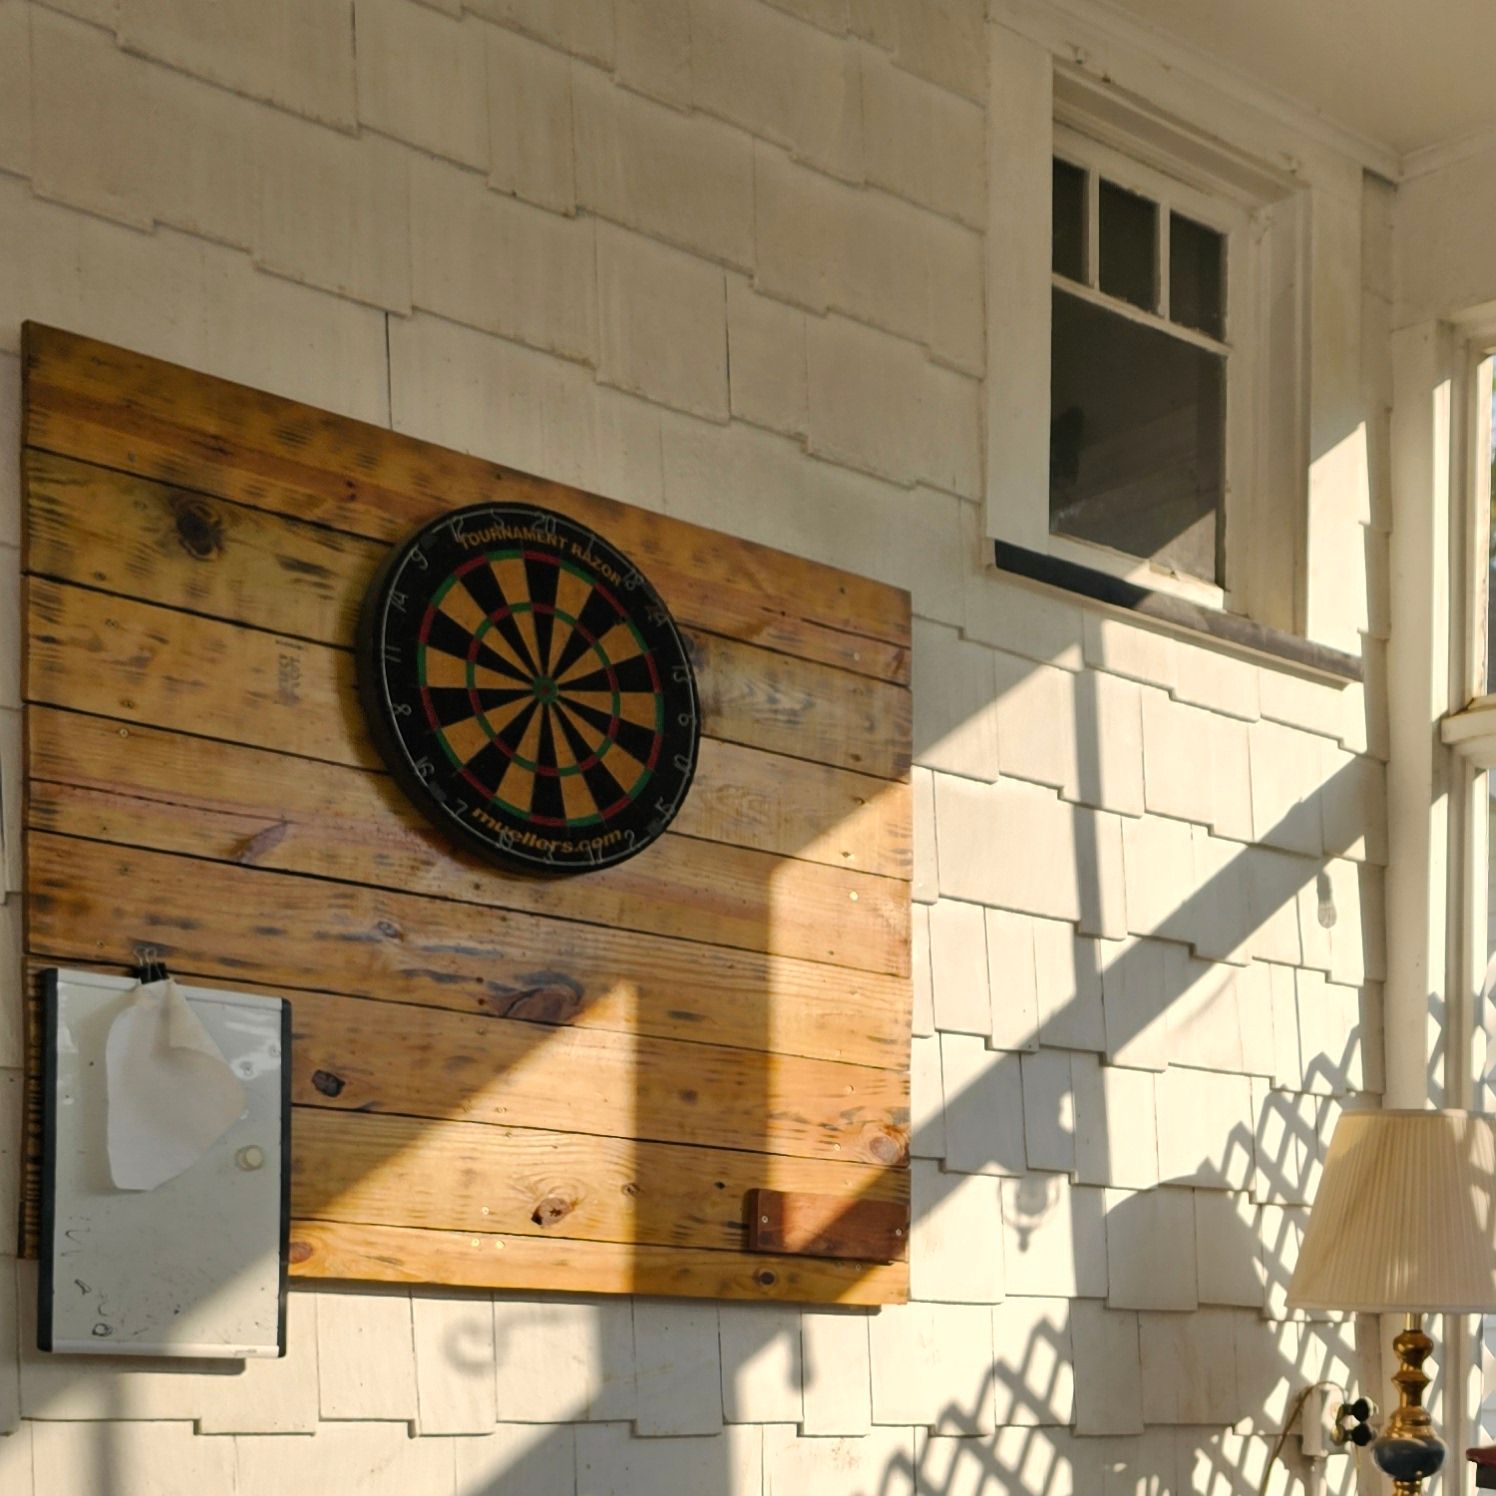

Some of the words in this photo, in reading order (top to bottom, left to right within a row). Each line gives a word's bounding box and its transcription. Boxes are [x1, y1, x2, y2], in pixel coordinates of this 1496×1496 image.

[460, 524, 568, 550] TOURNAMENT
[571, 542, 622, 588] RAZOR
[624, 829, 637, 851] 2
